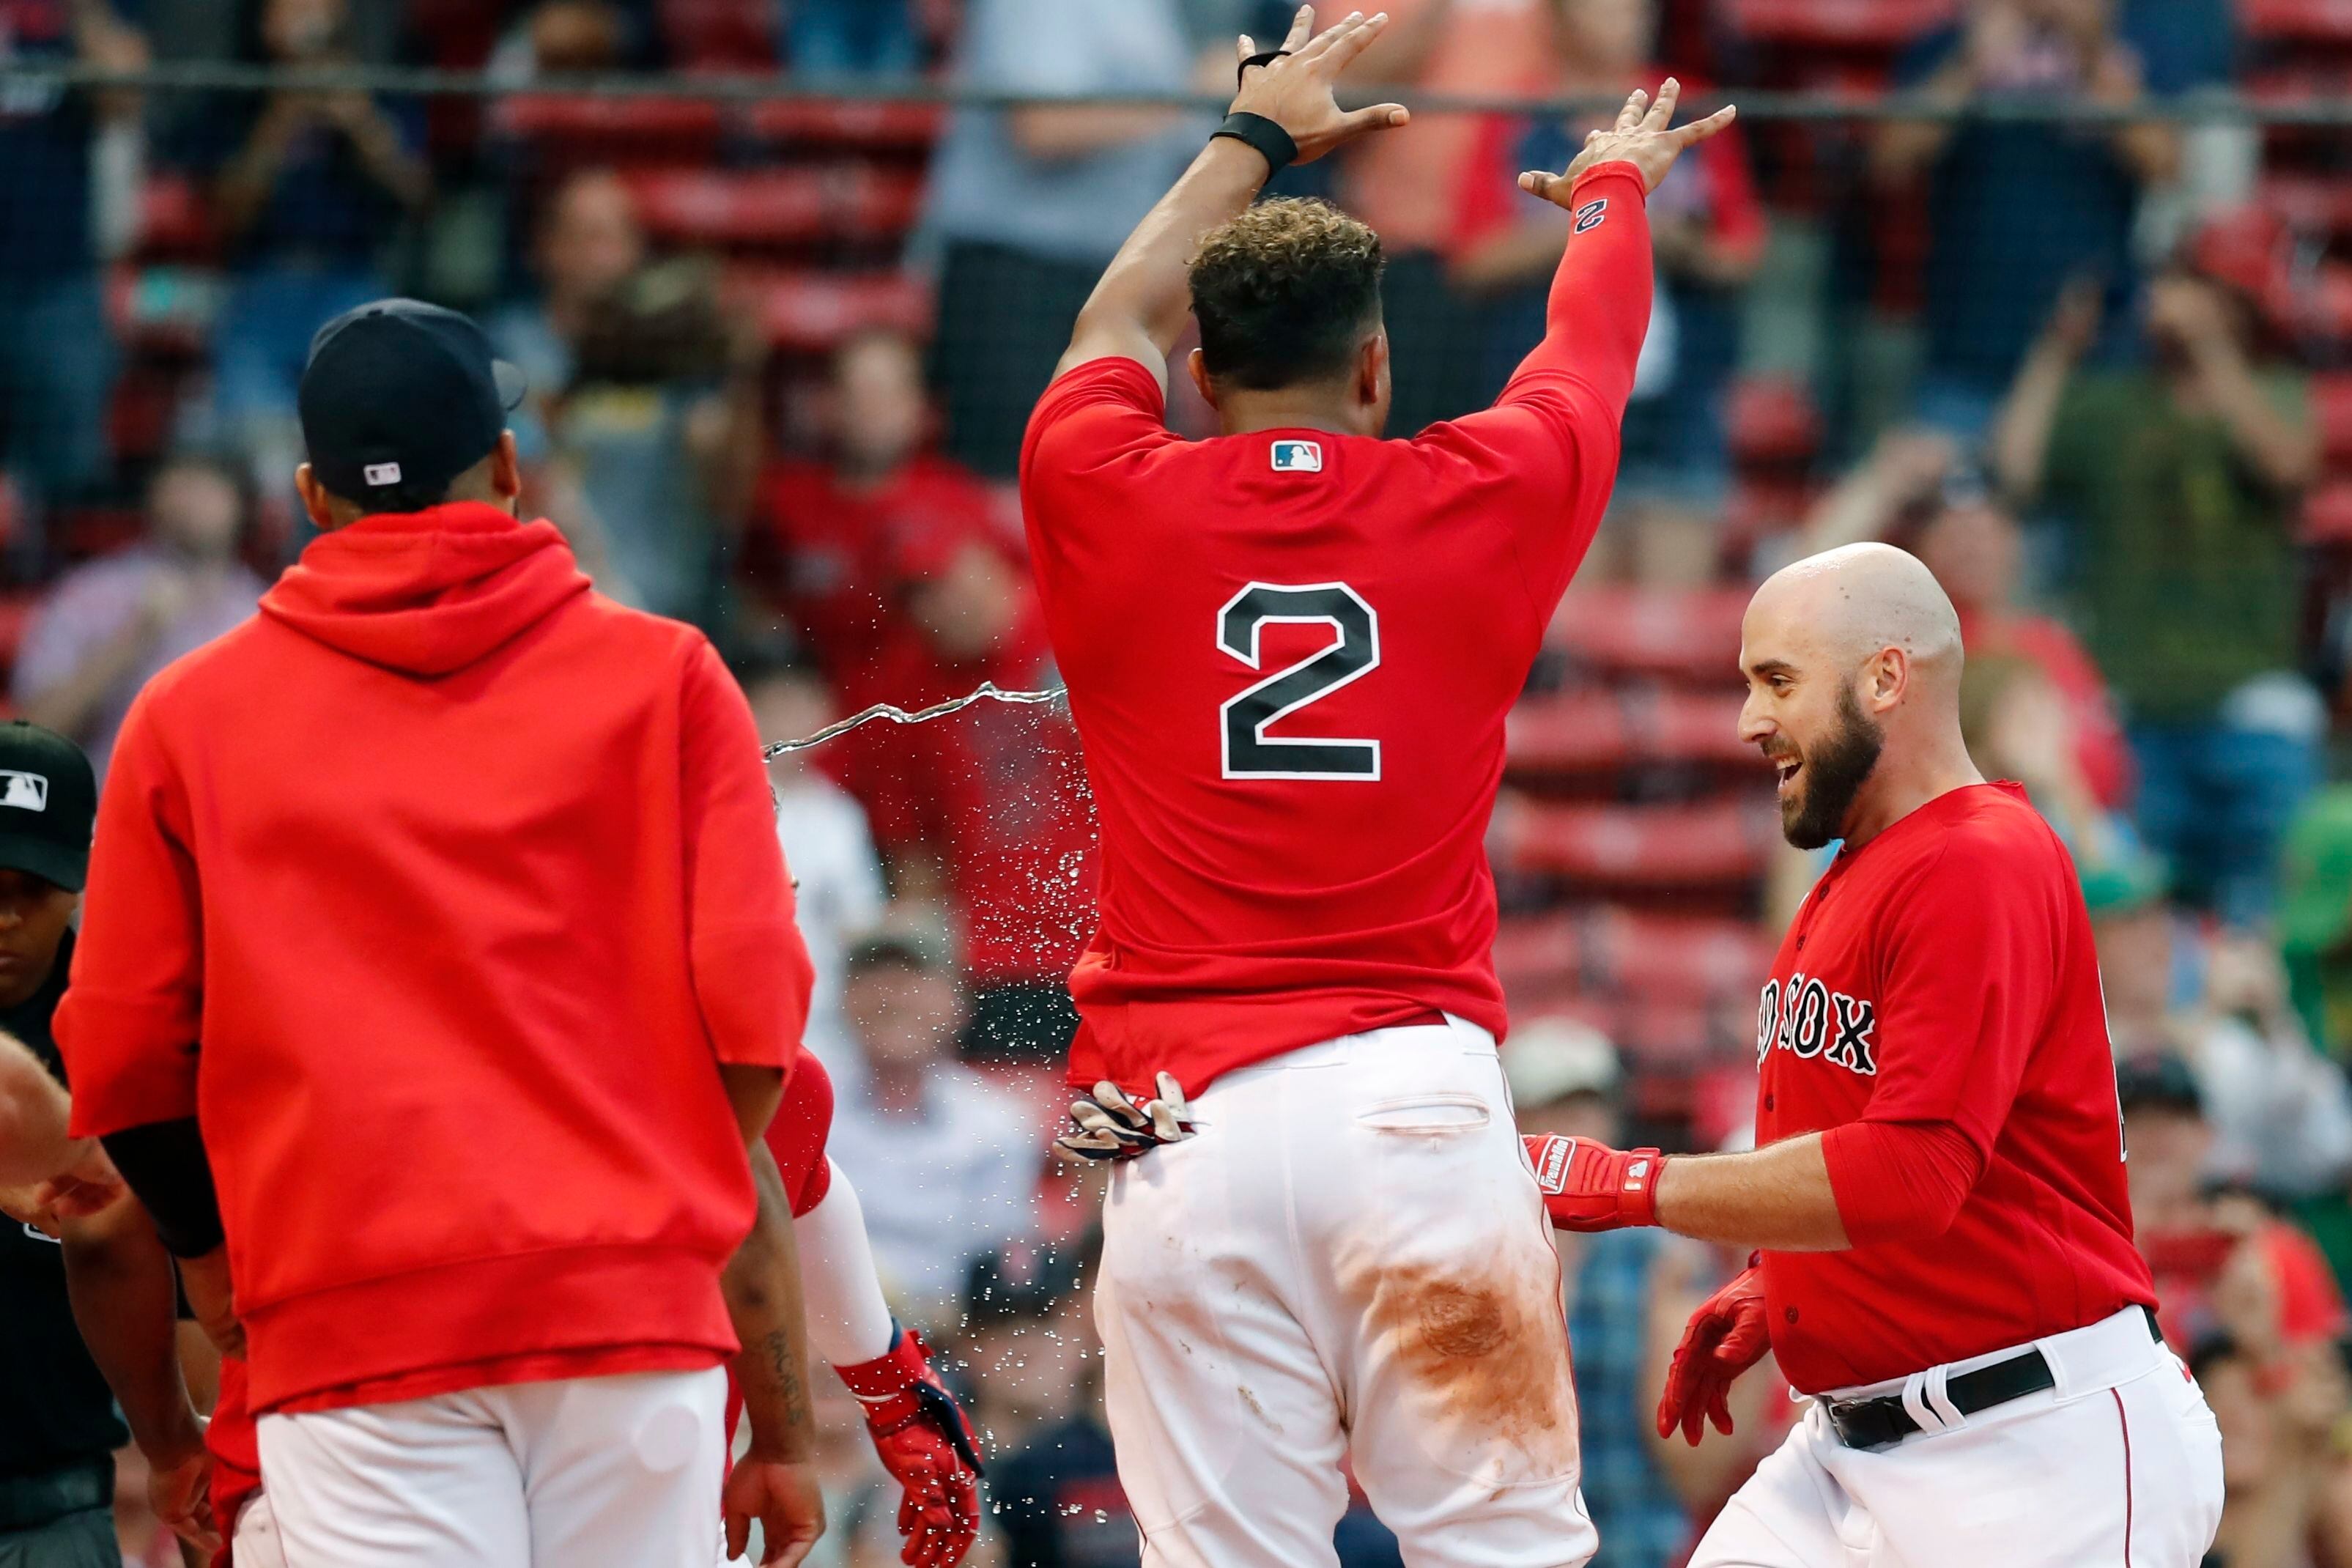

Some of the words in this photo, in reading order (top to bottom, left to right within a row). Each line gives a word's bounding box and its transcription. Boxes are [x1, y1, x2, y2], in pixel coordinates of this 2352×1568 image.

[1574, 199, 1608, 234] 2
[1216, 581, 1380, 781] 2
[1778, 972, 1876, 1076] SOX
[1539, 1139, 1569, 1192] Franklin
